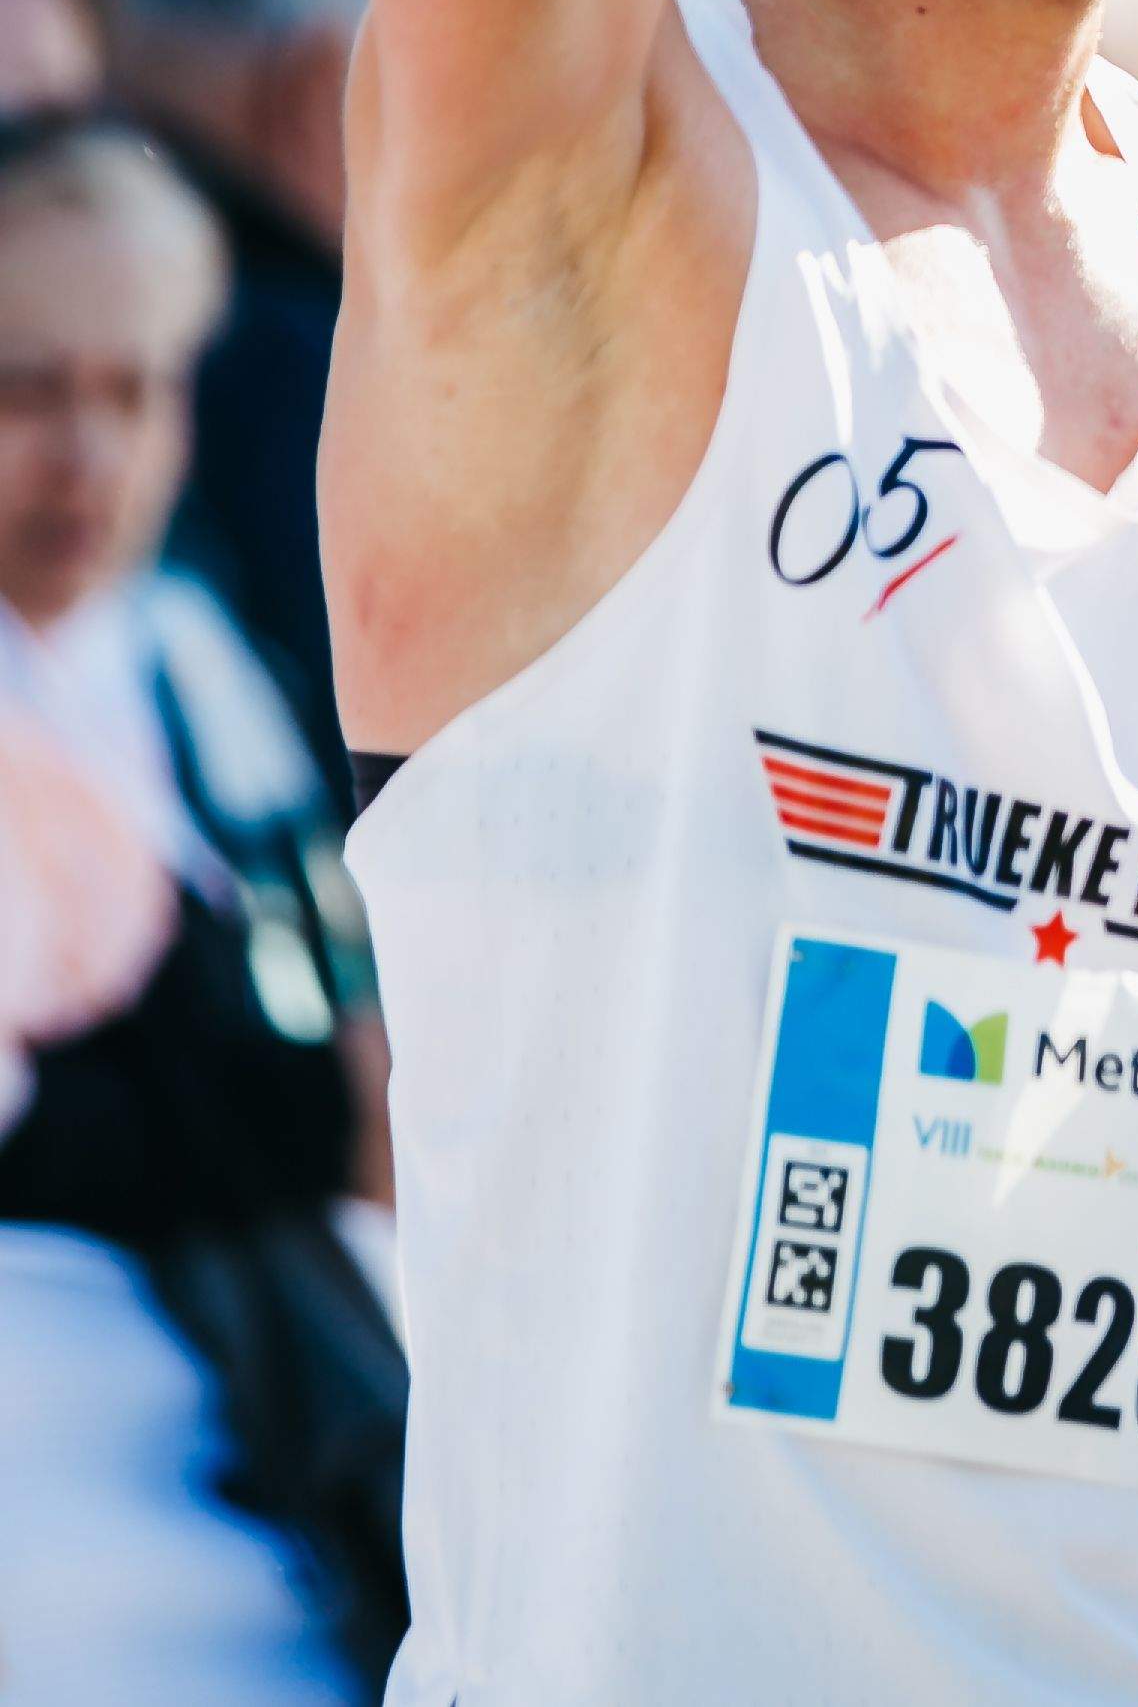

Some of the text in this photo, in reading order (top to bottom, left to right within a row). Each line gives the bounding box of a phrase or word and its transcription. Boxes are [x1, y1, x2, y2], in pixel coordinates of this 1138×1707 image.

[768, 436, 964, 586] 05
[891, 769, 1131, 906] TRUEKE
[912, 1114, 973, 1158] VIII
